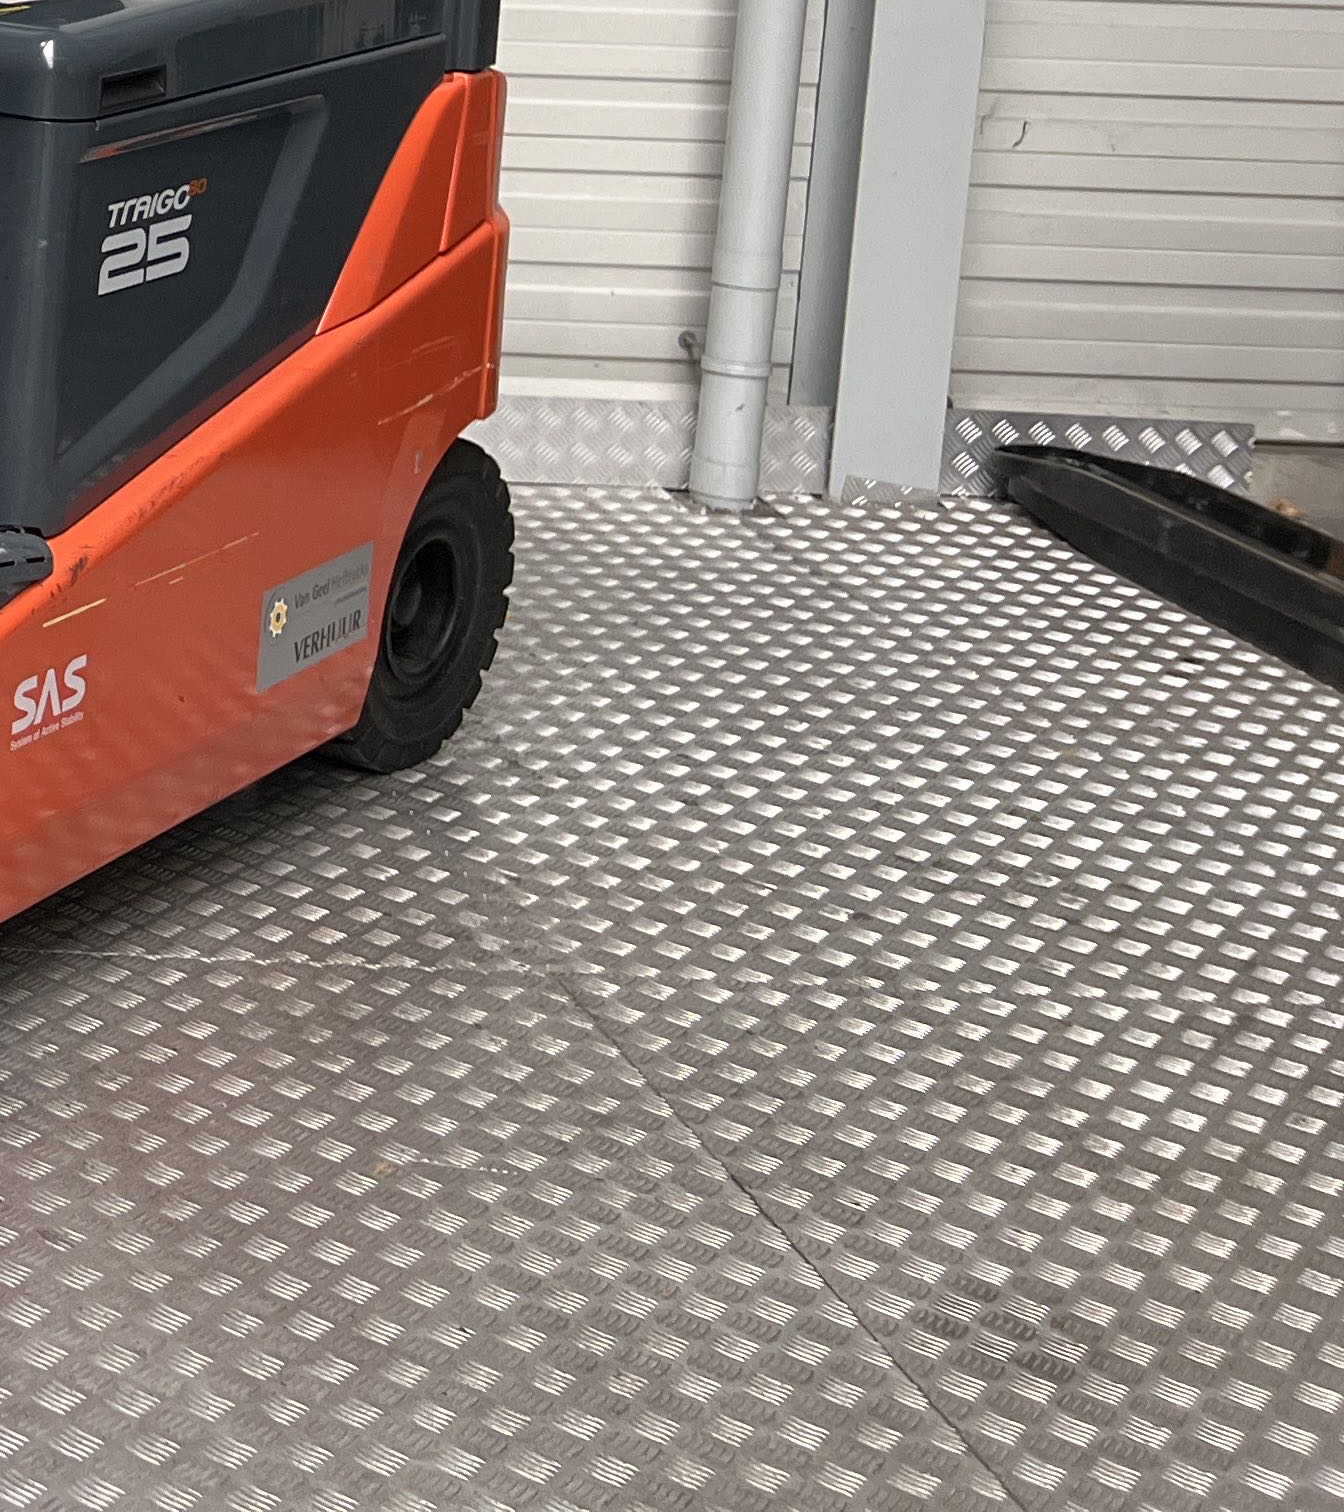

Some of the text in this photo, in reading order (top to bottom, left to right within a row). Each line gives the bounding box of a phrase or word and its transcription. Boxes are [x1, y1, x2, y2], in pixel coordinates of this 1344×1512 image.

[97, 214, 193, 296] 25
[294, 589, 310, 609] Van
[312, 578, 331, 601] Geel
[294, 609, 362, 664] VERHUUR
[10, 653, 88, 736] SAS
